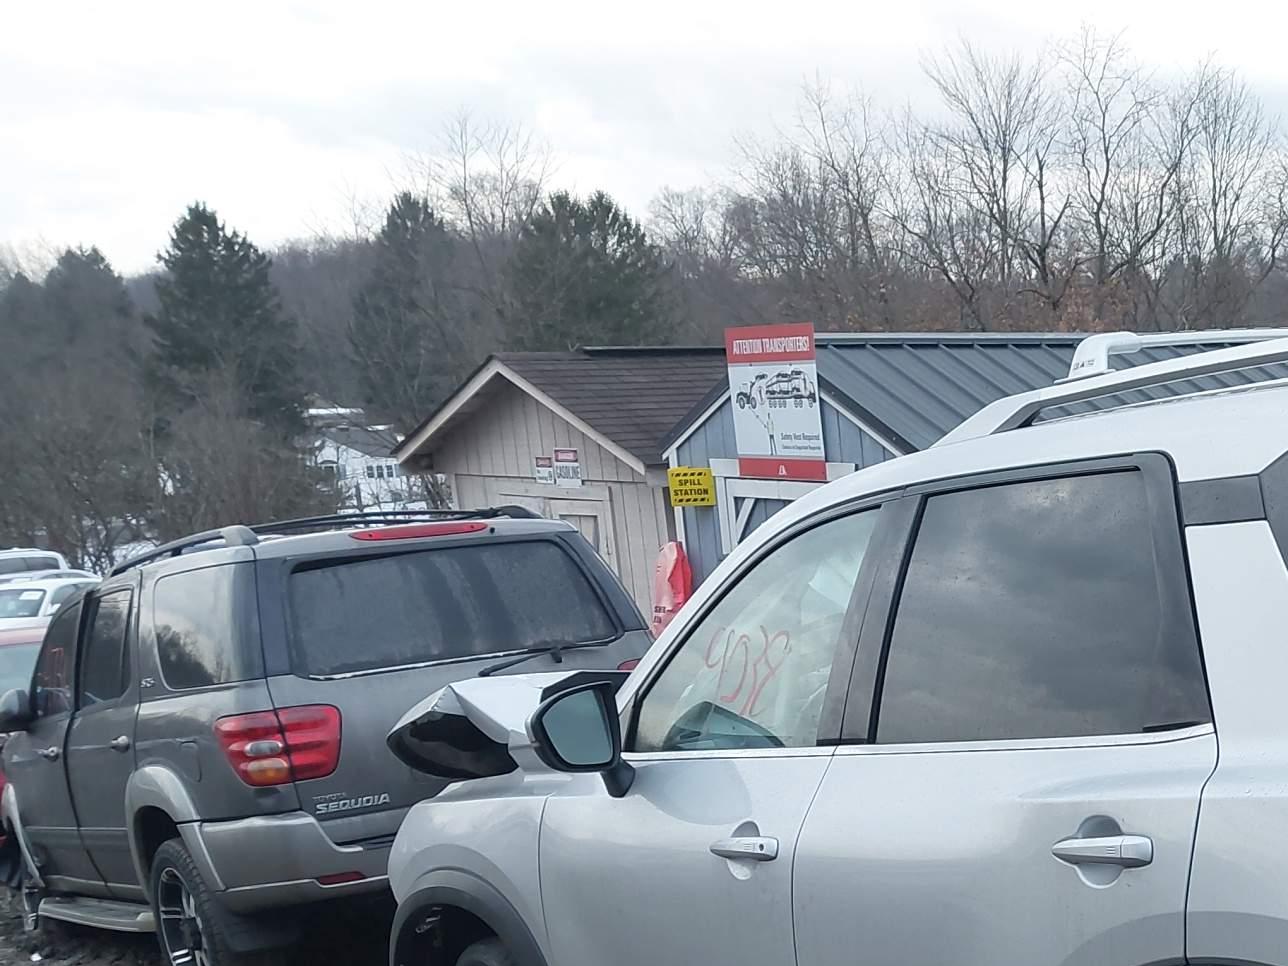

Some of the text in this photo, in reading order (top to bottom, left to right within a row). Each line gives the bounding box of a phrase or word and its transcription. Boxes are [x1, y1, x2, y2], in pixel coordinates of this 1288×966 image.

[733, 335, 810, 355] ATTENTION TRANSPORTERS!
[678, 478, 703, 487] SPILL
[673, 488, 709, 497] STATION
[315, 793, 391, 815] SEQUOIA
